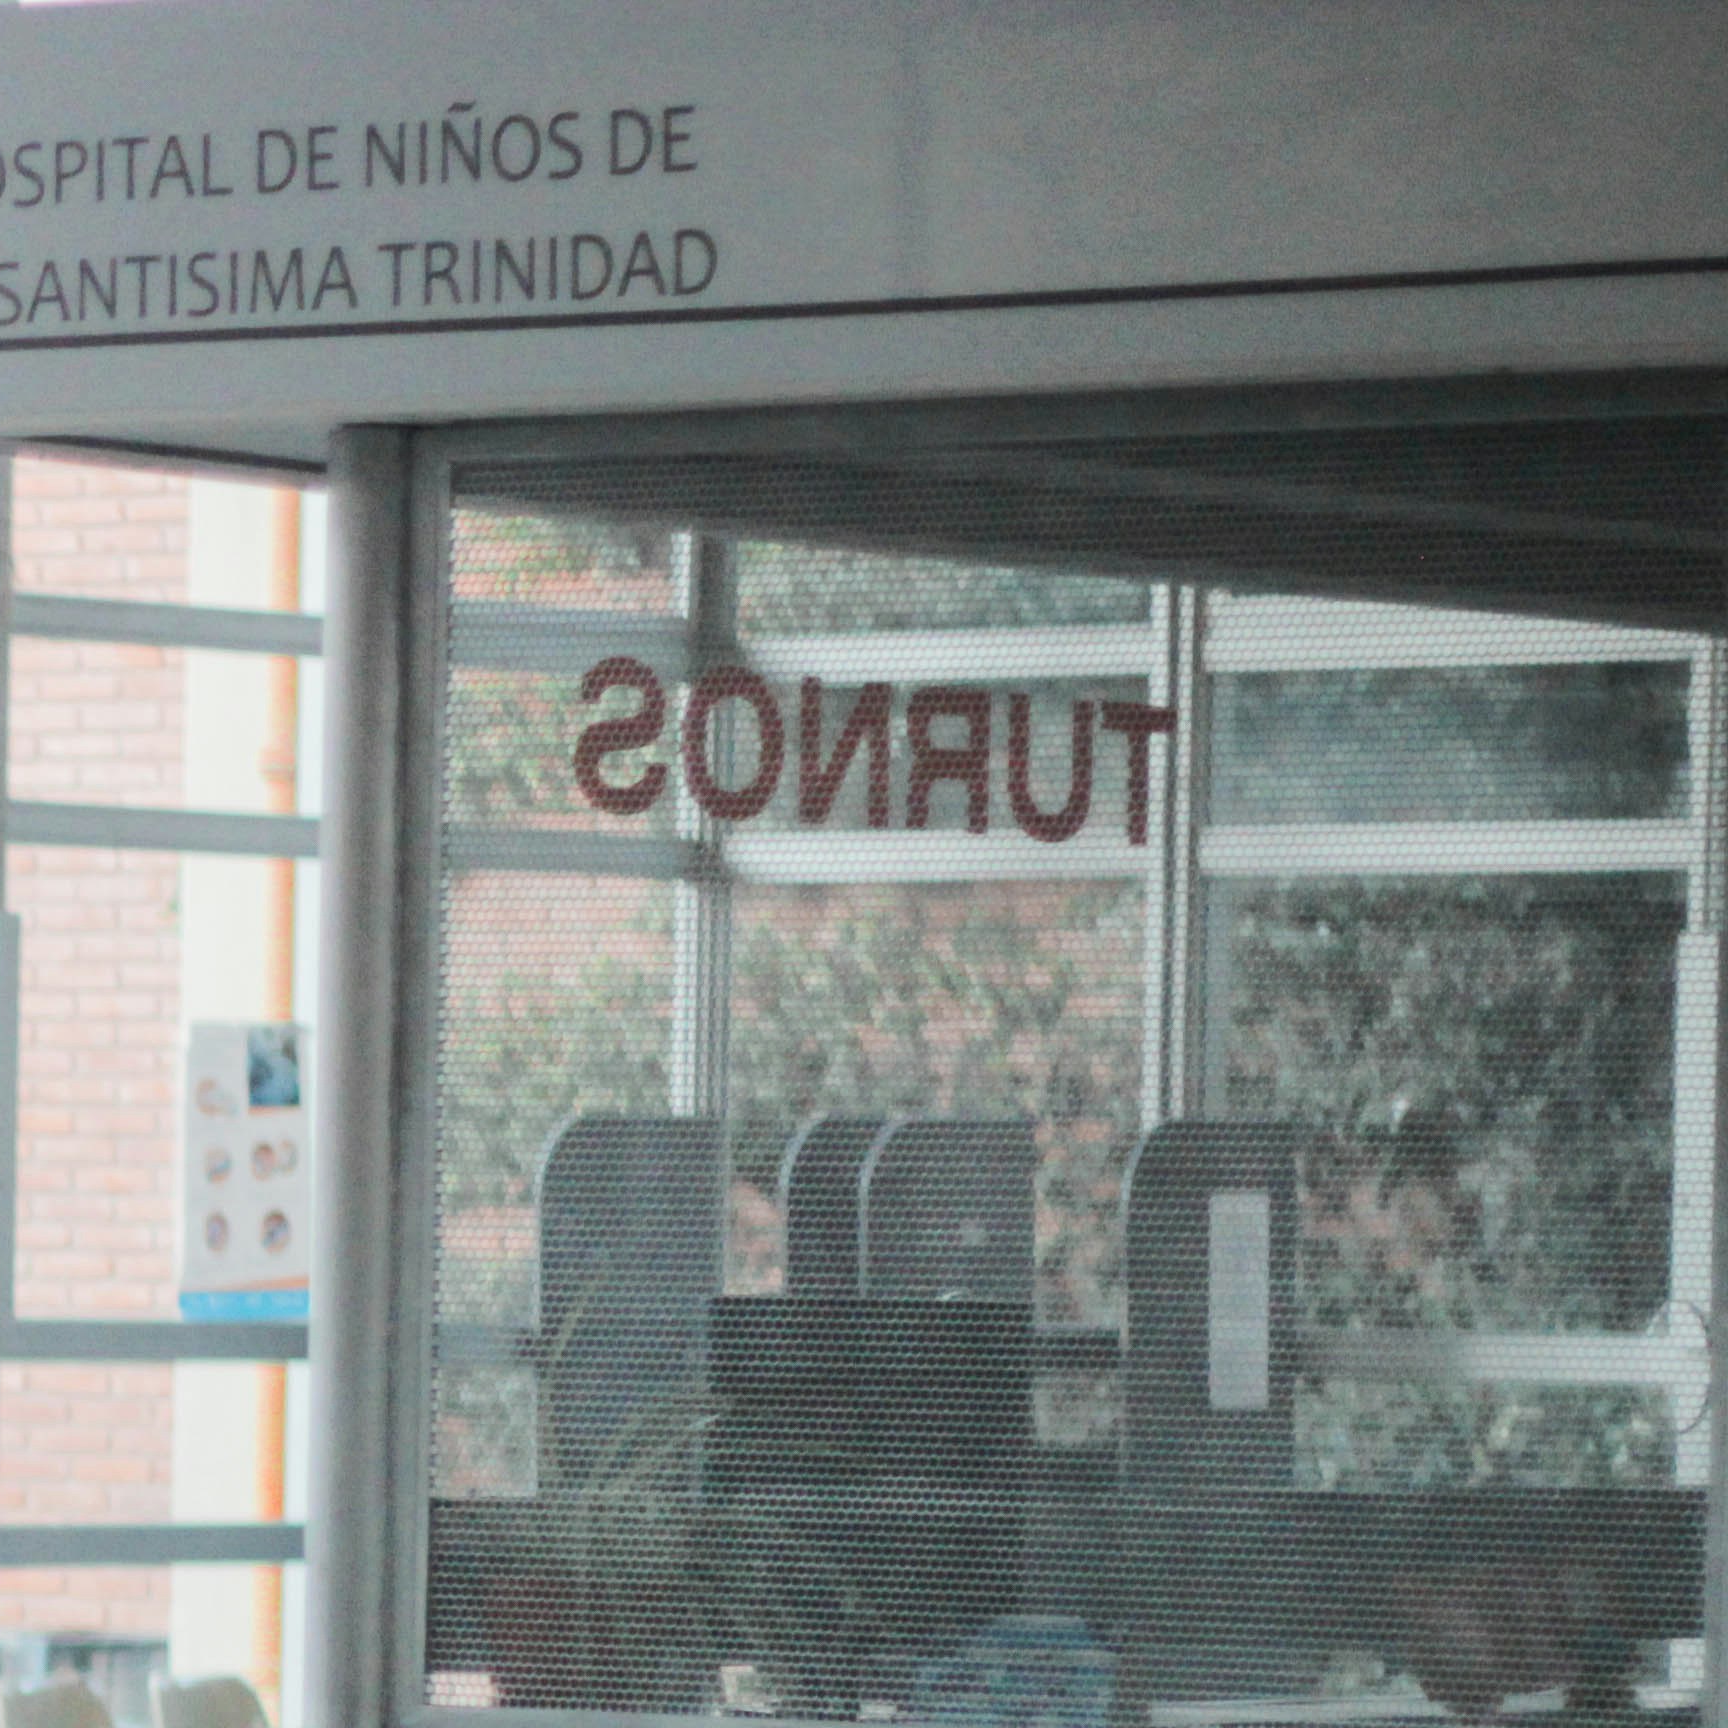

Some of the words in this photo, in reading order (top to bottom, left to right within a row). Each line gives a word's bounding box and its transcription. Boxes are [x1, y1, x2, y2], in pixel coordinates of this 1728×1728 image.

[256, 125, 340, 194] DE
[364, 102, 583, 187] NIÑOS
[609, 104, 697, 175] DE
[378, 228, 718, 306] TRINIDAD
